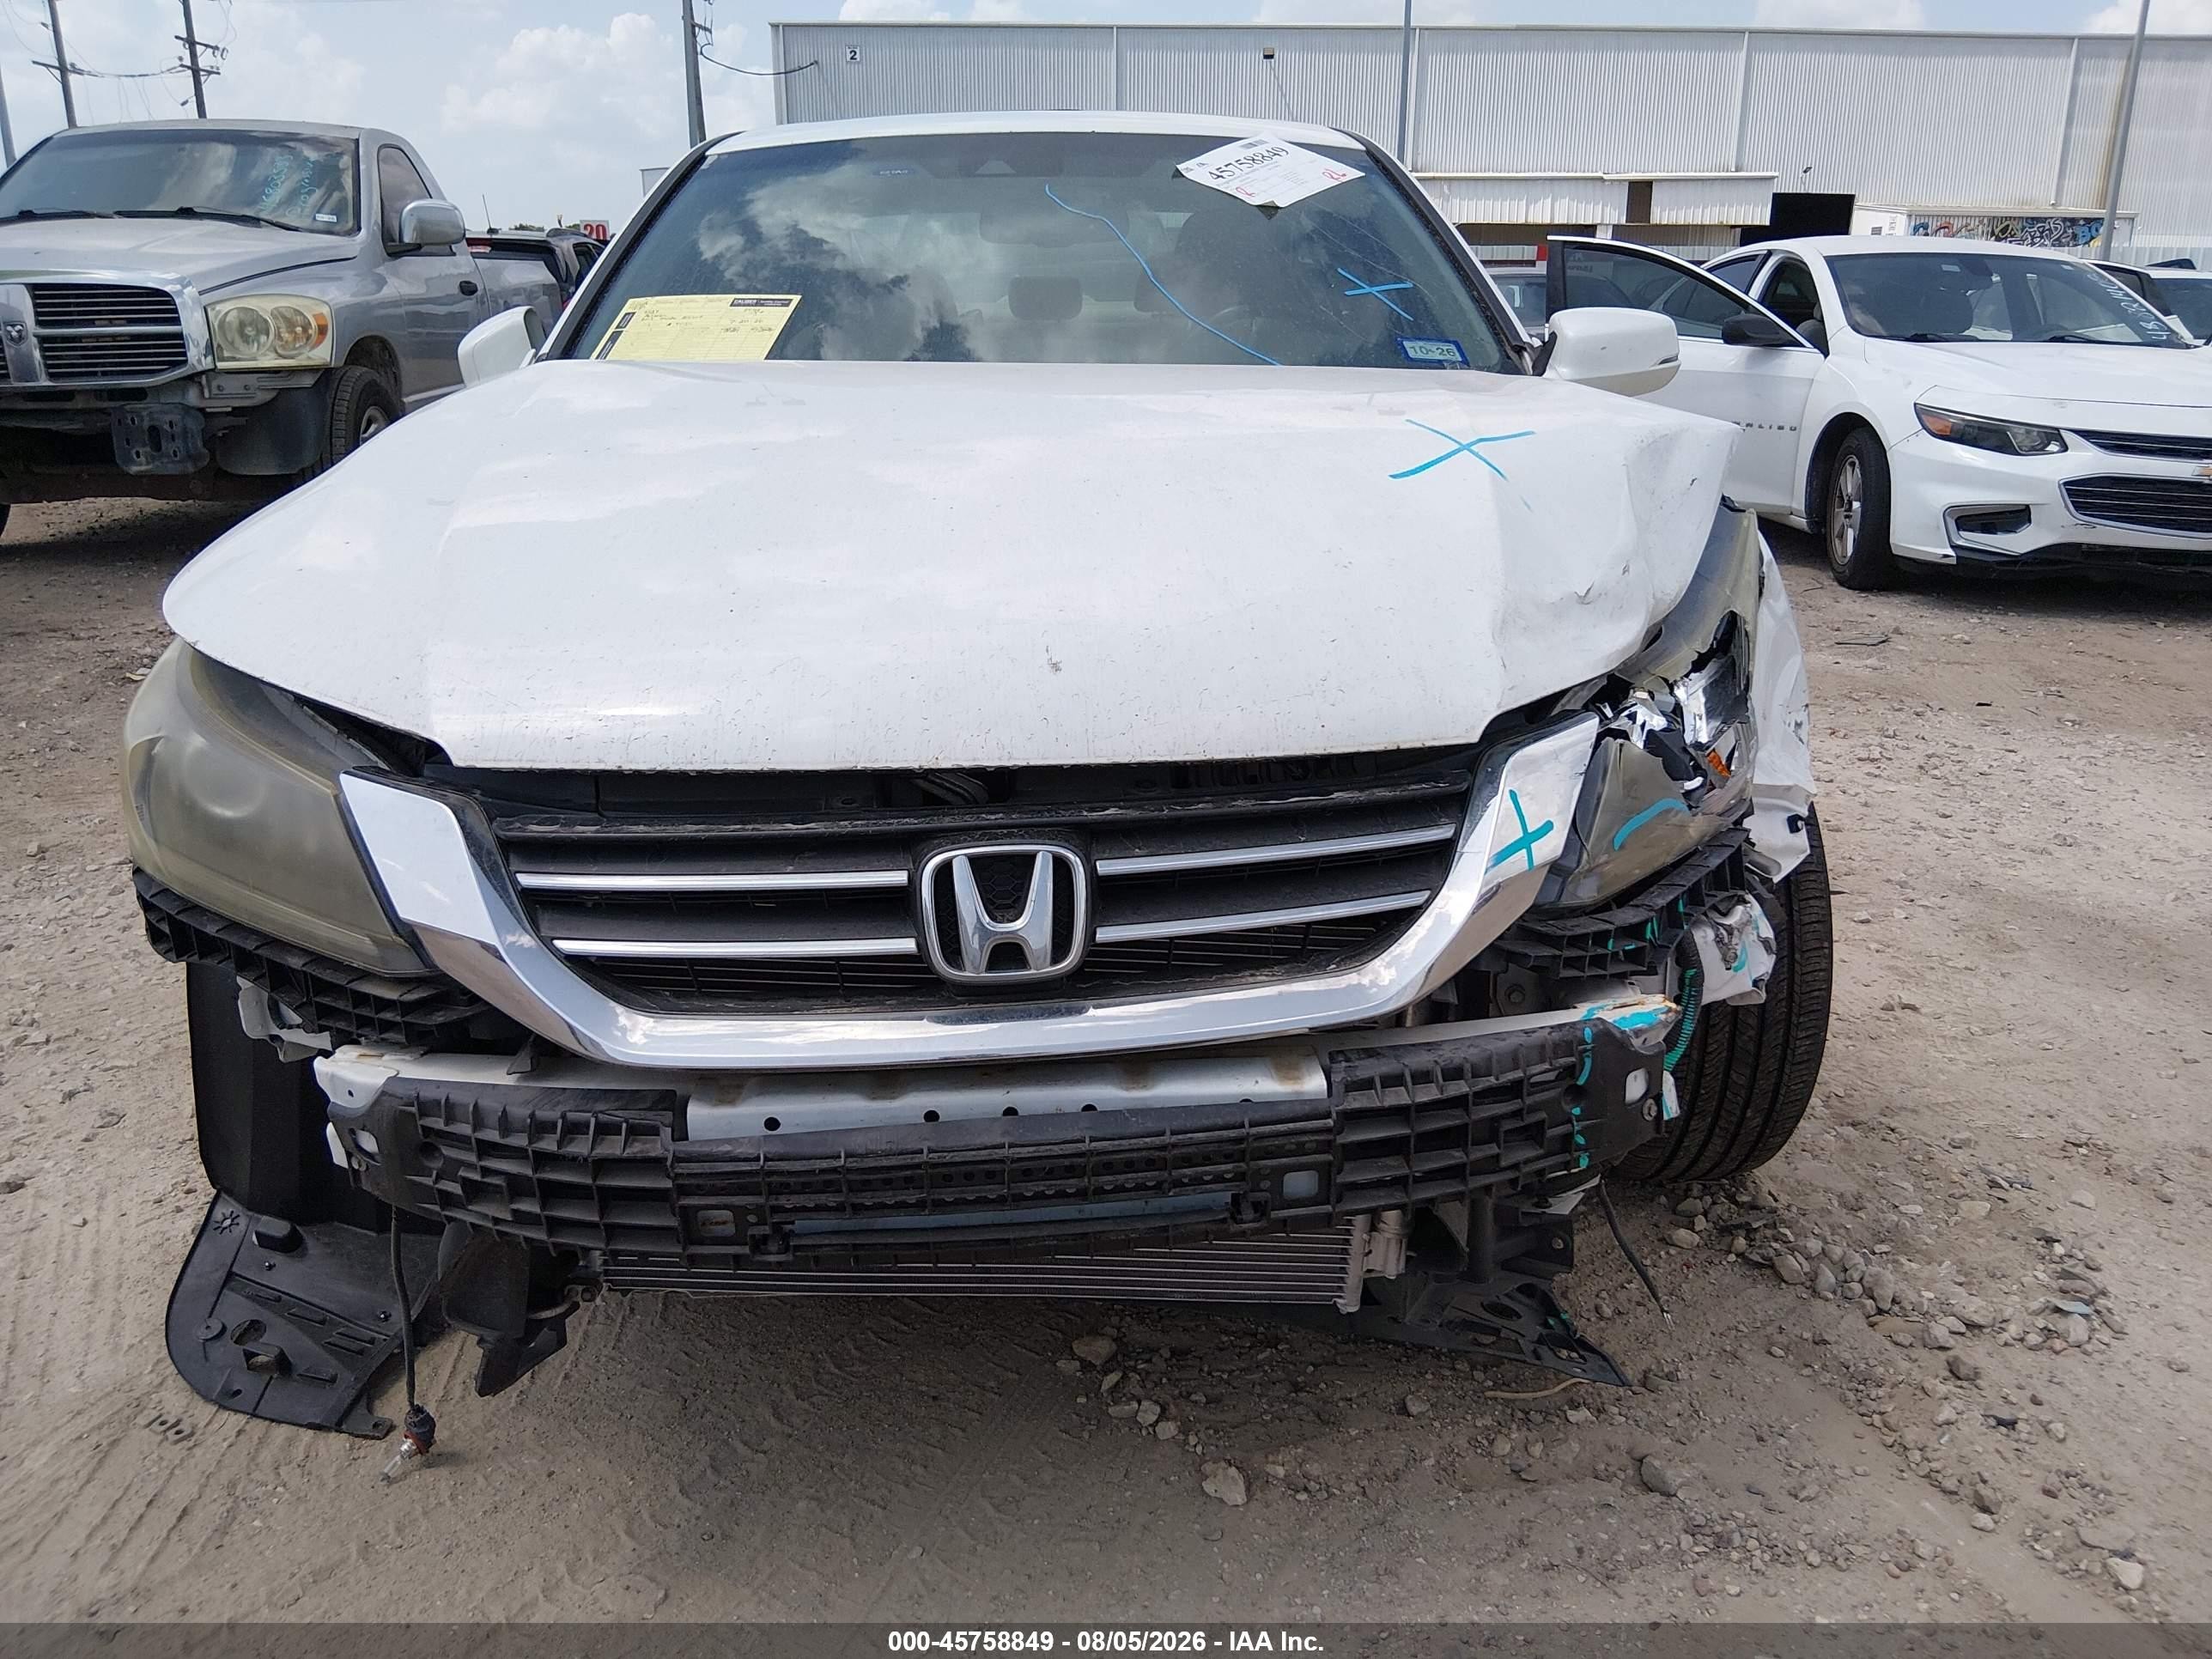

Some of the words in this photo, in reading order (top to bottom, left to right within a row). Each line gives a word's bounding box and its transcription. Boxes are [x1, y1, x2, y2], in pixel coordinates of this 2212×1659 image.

[849, 49, 858, 60] 2
[1208, 146, 1289, 180] 45758849
[584, 223, 607, 240] 20
[1408, 346, 1456, 357] 10-26
